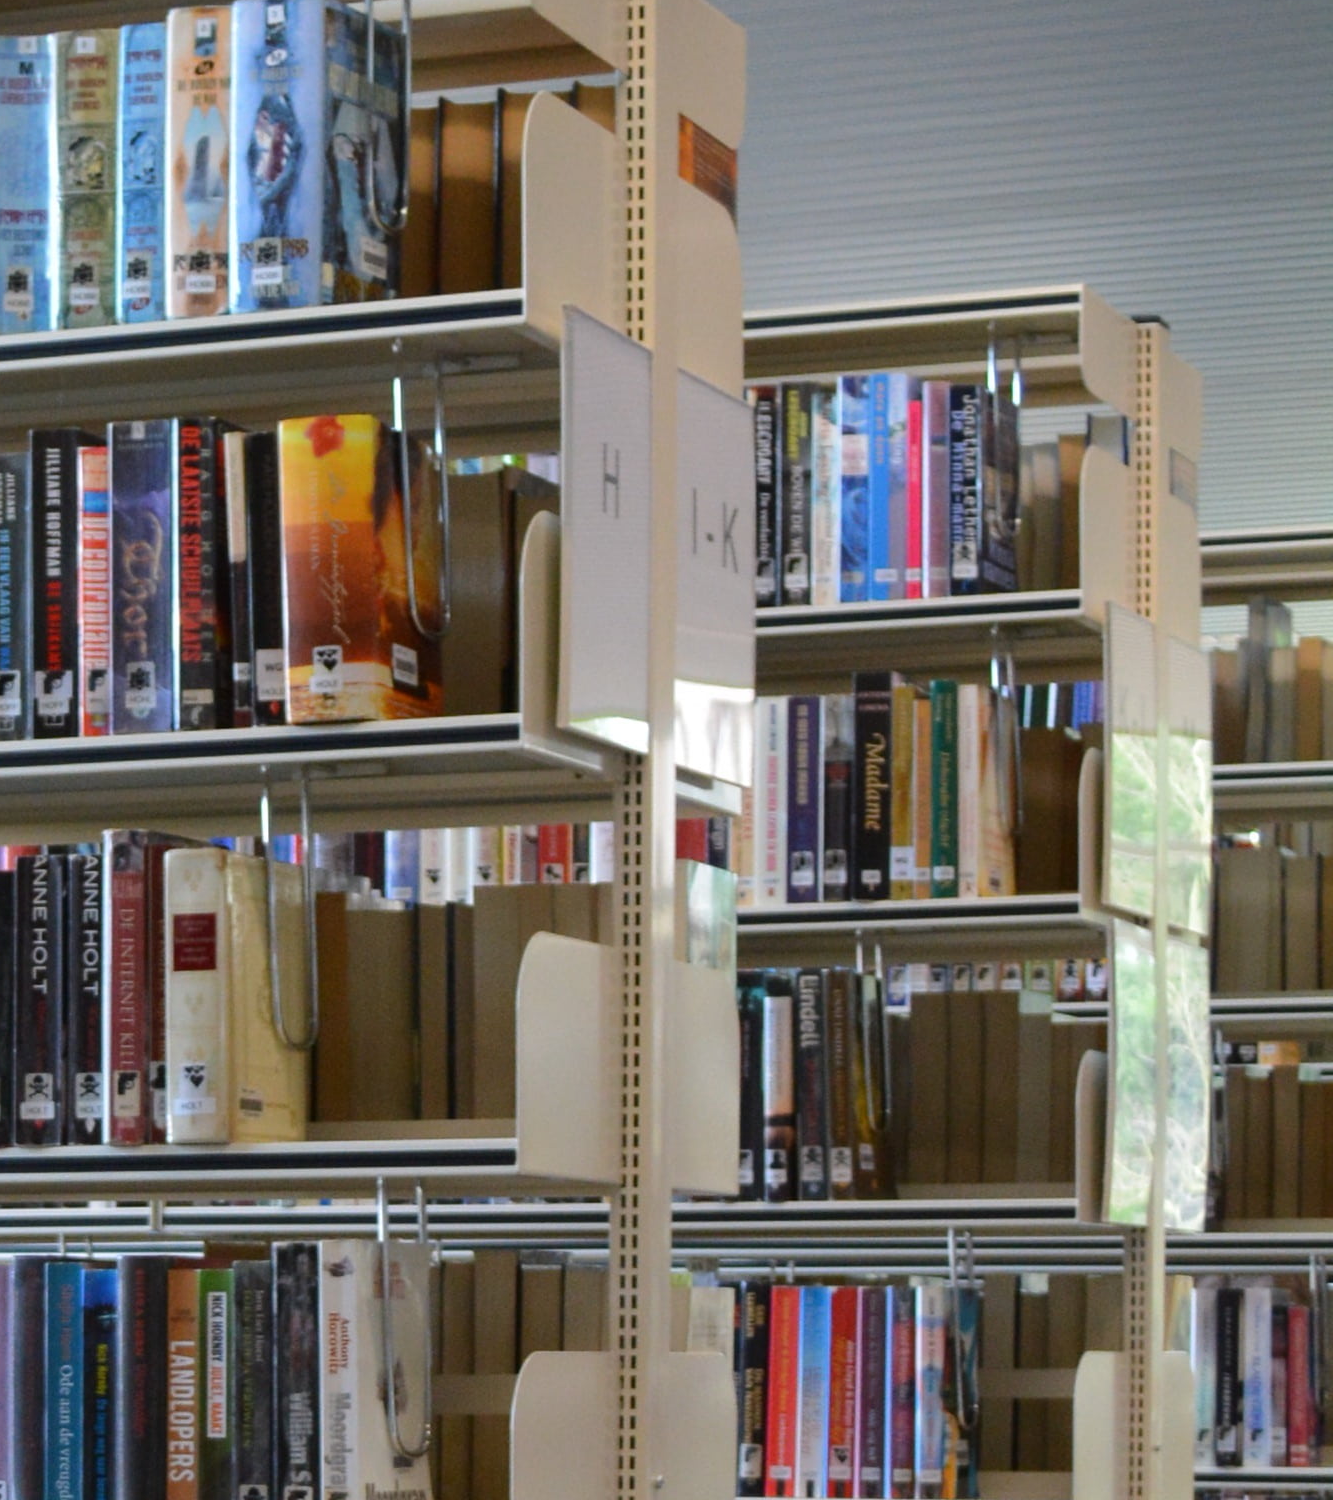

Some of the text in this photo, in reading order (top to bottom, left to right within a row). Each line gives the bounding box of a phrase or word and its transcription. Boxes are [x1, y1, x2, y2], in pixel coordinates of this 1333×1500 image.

[46, 448, 61, 577] JILLIANE HOFFMAN
[604, 443, 619, 519] H
[864, 733, 891, 831] Madame
[800, 974, 820, 1048] Lindell
[210, 1295, 224, 1361] NICK HORNBY
[61, 1365, 74, 1396] Ode
[61, 1400, 72, 1426] aan
[168, 1339, 196, 1483] LANDLOPERS
[60, 1430, 73, 1447] de
